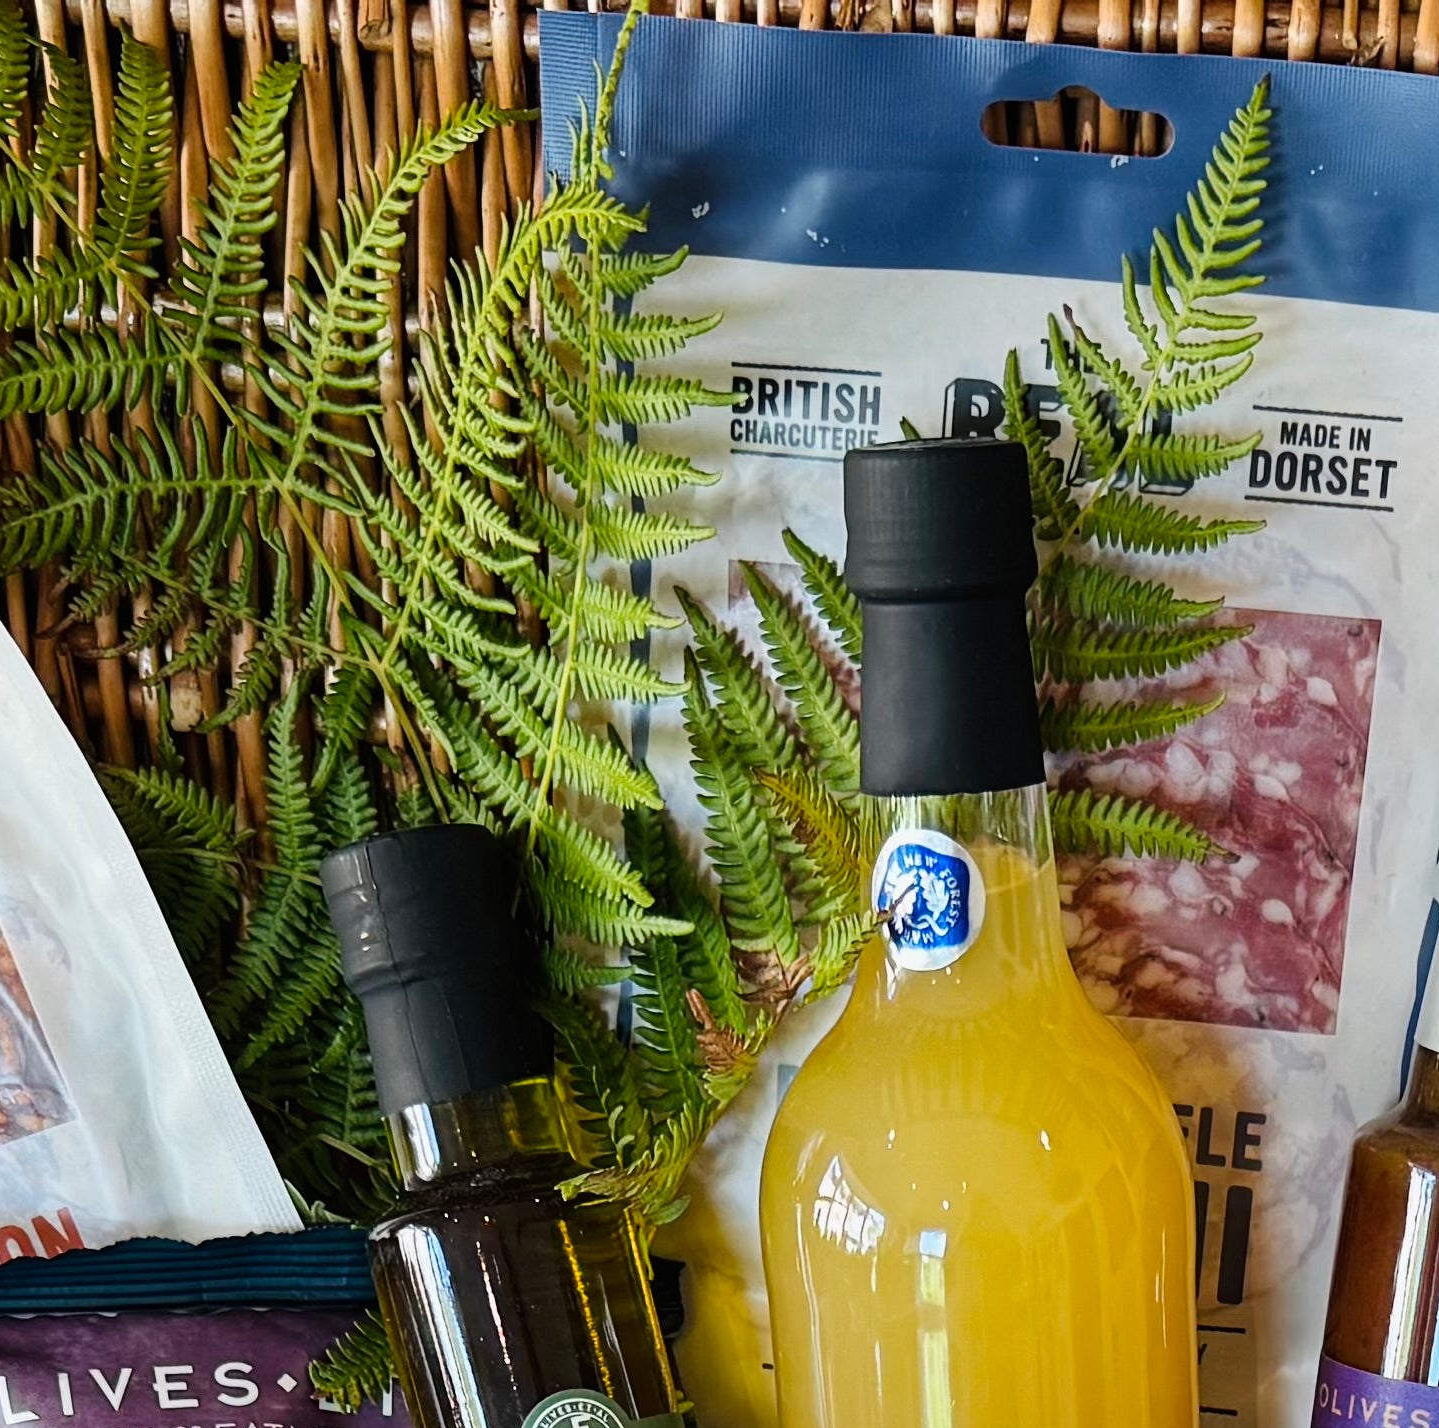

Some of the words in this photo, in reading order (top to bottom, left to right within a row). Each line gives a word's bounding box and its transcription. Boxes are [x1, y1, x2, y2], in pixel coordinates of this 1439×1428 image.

[1280, 422, 1341, 447] MADE
[1347, 426, 1371, 451] IN
[1249, 450, 1398, 499] DORSET
